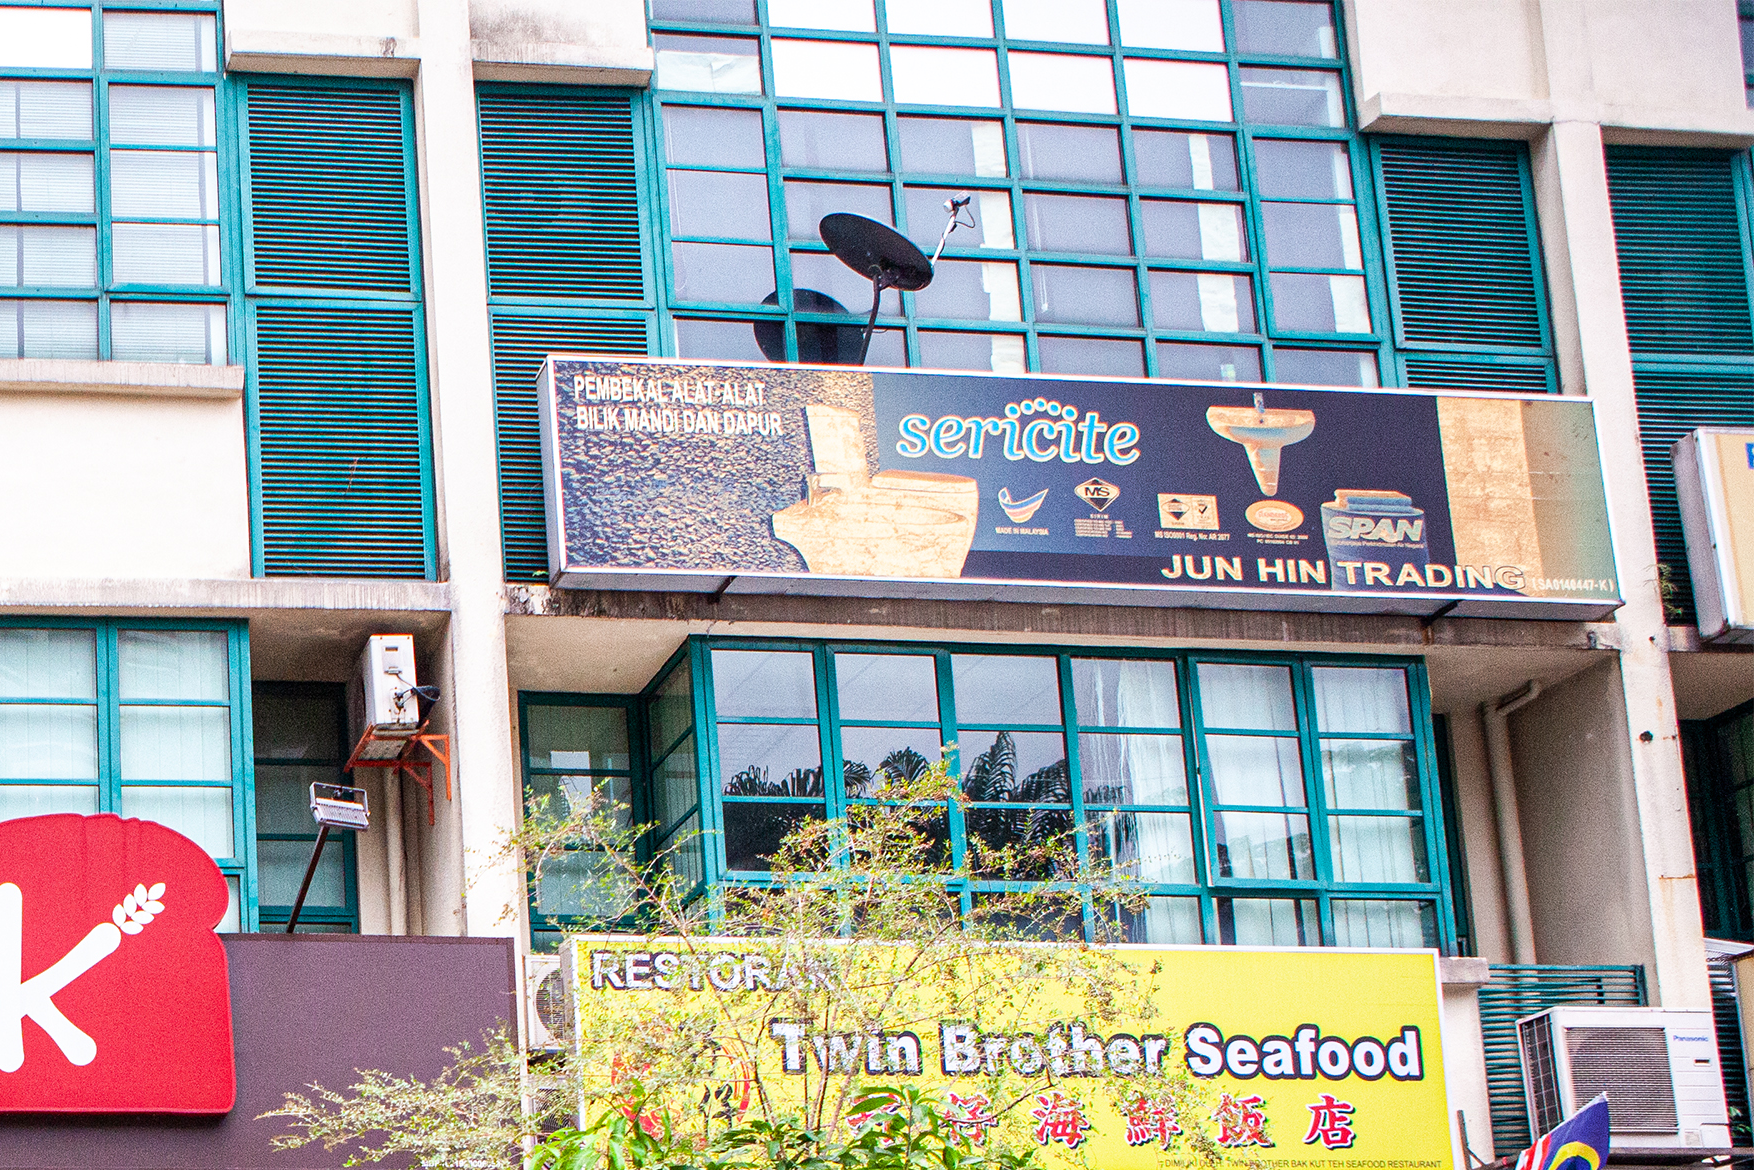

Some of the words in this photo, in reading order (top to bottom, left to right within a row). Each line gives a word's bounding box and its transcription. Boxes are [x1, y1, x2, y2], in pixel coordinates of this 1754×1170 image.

[574, 374, 669, 402] PEMBEKAL
[672, 379, 766, 405] ALAT-ALAT
[576, 405, 621, 430] BILIK
[624, 407, 680, 432] MANDI
[683, 409, 720, 434] DAN
[723, 411, 784, 436] DAPUR
[896, 397, 1141, 466] sericite
[1084, 486, 1111, 497] MS
[996, 527, 1012, 535] MADE
[1328, 516, 1424, 542] SPAN
[1160, 555, 1243, 580] JUN
[1258, 558, 1328, 584] HIN
[1337, 561, 1527, 590] TRADING
[768, 1017, 924, 1077] Twin
[938, 1019, 1169, 1078] Brother
[1184, 1022, 1425, 1081] Seafood
[1291, 1159, 1308, 1168] BAK
[1309, 1159, 1327, 1168] KUT
[1328, 1159, 1344, 1169] TEH
[1345, 1159, 1386, 1169] SEAFOOD
[1387, 1159, 1442, 1169] RESTAURANT
